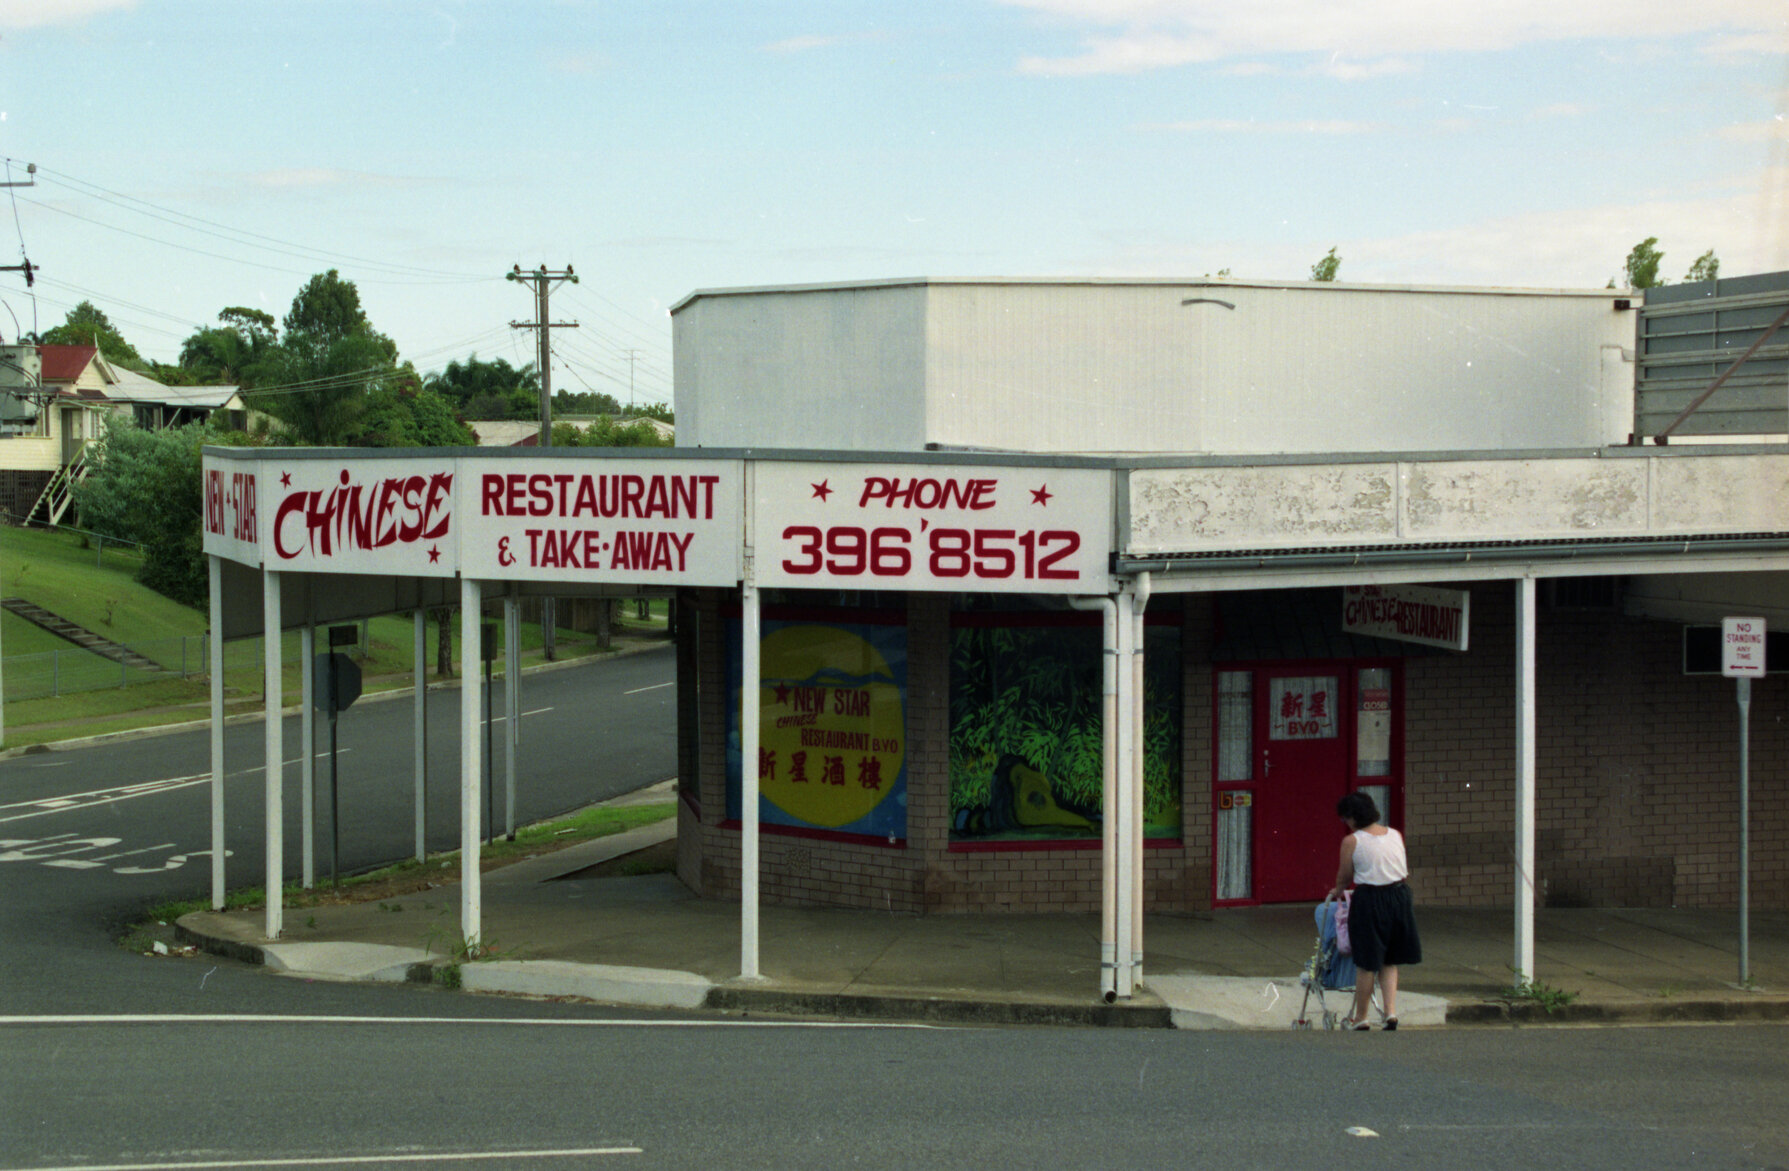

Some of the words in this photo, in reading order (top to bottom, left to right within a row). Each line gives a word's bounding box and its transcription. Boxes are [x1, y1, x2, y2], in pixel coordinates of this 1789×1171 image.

[205, 469, 226, 536] NEW
[232, 473, 258, 544] STAR
[481, 473, 720, 520] RESTAURANT
[858, 477, 998, 511] PHONE
[273, 468, 454, 560] CHINESE
[497, 535, 517, 567] &
[1396, 601, 1463, 643] RESTAURANT
[1736, 623, 1752, 633] NO
[1727, 633, 1761, 643] STANDING
[794, 686, 826, 714] NEW
[834, 688, 870, 717] STAR
[1281, 691, 1327, 718] 新星
[776, 713, 818, 729] CHINESE
[1288, 721, 1319, 735] BYO
[801, 728, 870, 751] RESTAURANT
